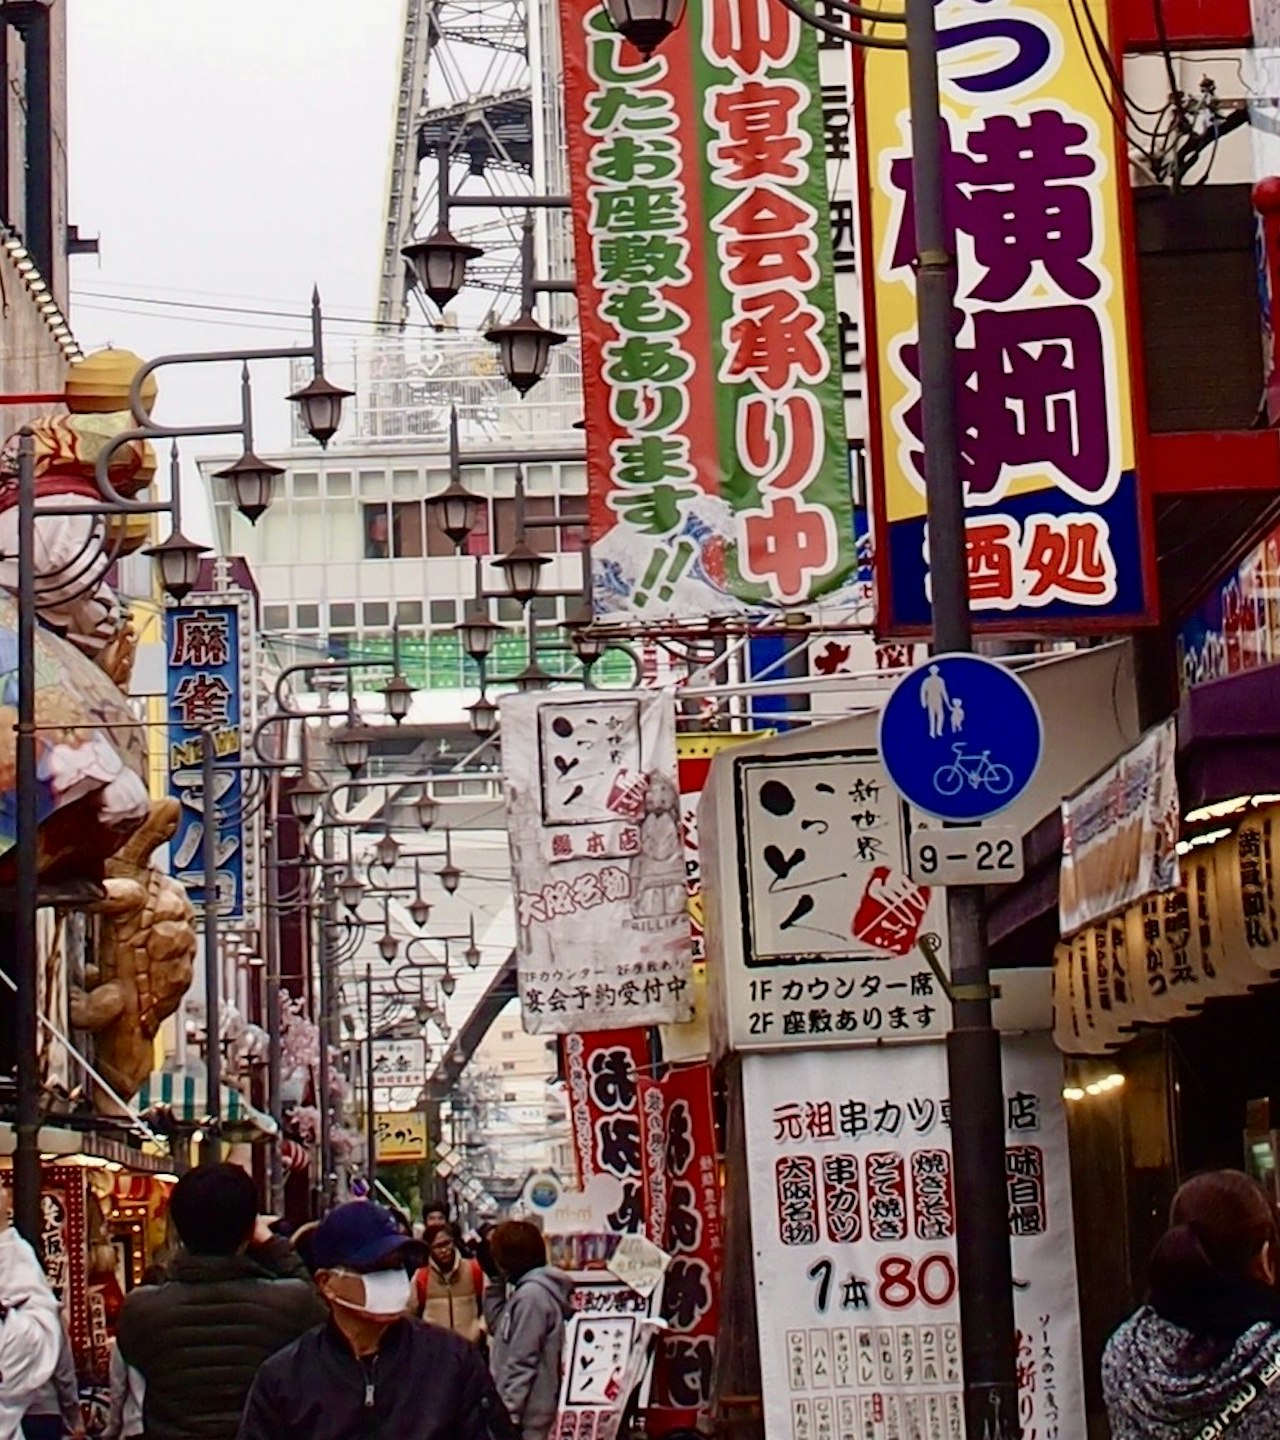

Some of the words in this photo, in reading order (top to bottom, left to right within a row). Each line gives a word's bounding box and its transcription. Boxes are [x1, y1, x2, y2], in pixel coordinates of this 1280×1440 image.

[890, 109, 1109, 495] 横綱
[170, 610, 232, 728] 麻雀
[525, 975, 687, 1014] 宴会予約受付中
[750, 980, 772, 1001] 1F
[782, 972, 933, 1001] カウンター席
[750, 1014, 773, 1034] 2F
[783, 1005, 937, 1034] 座敷あります
[824, 1156, 860, 1242] 串カツ
